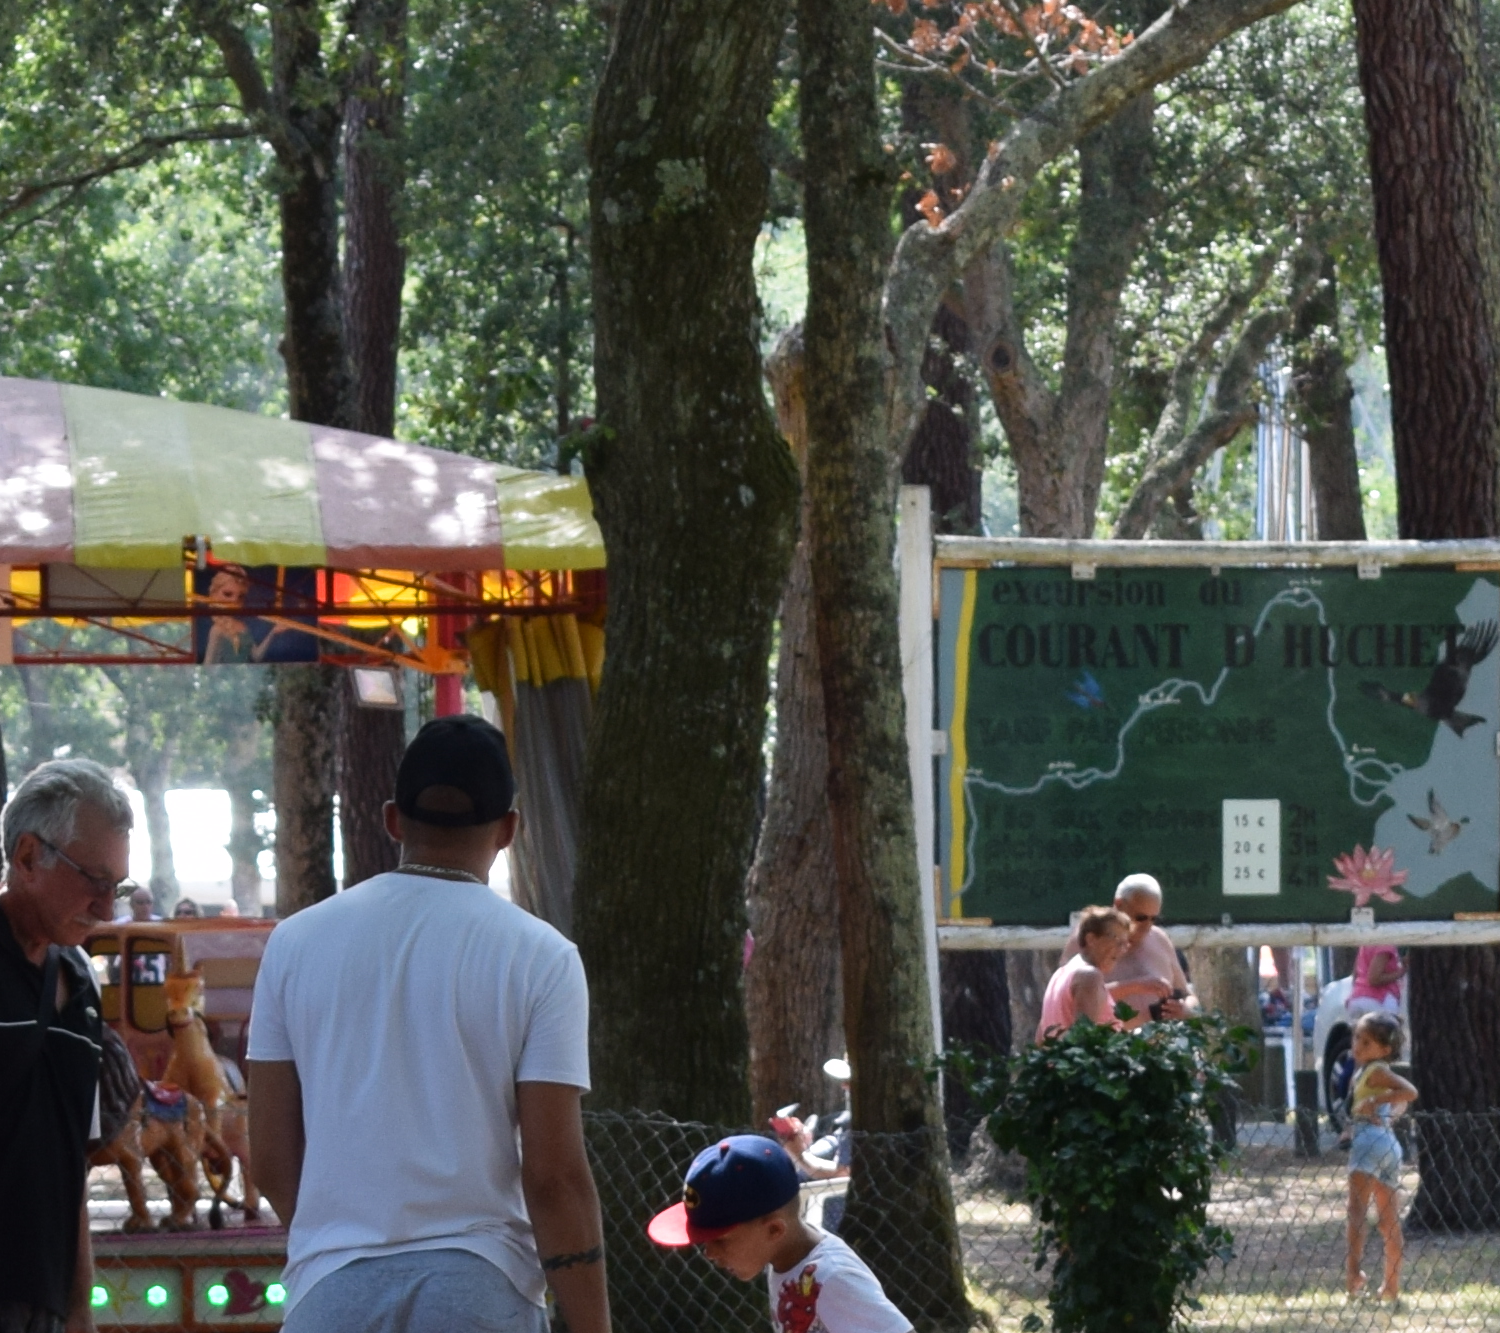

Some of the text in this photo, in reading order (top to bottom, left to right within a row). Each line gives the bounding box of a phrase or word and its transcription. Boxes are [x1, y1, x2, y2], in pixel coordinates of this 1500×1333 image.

[991, 570, 1245, 607] excursion du
[976, 622, 1189, 669] COURANT
[1234, 813, 1249, 828] 15
[1234, 840, 1251, 854] 20
[1234, 865, 1251, 880] 25
